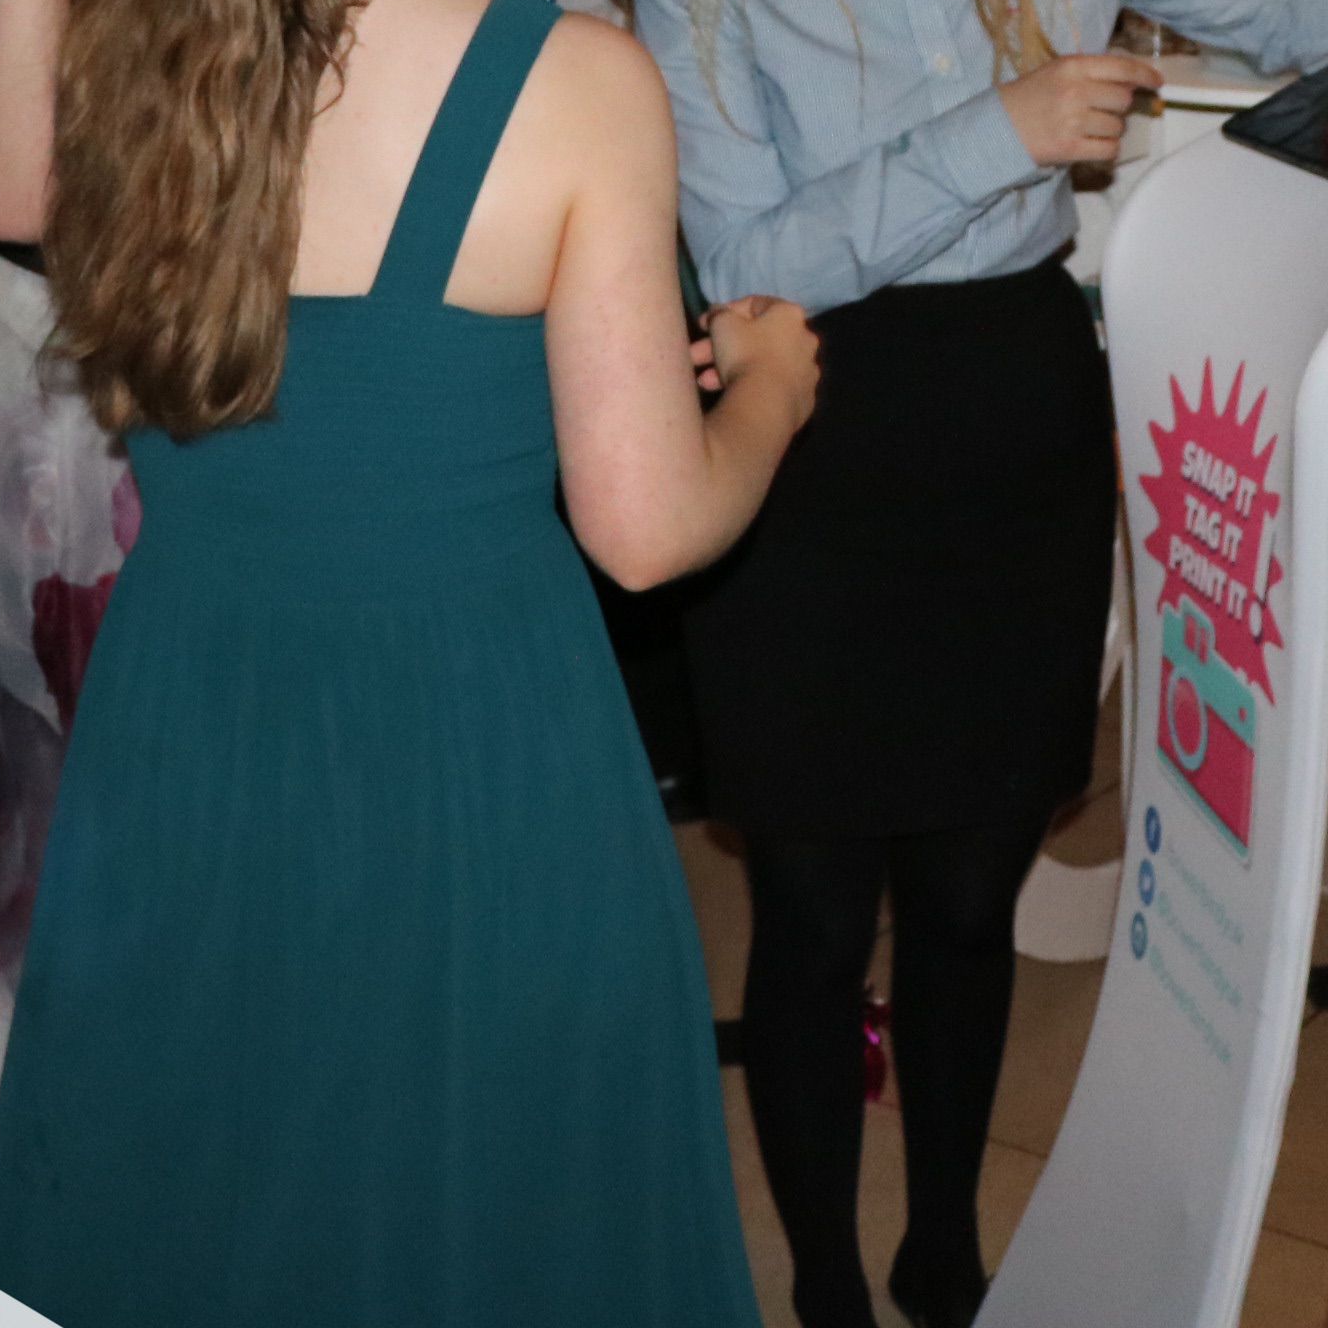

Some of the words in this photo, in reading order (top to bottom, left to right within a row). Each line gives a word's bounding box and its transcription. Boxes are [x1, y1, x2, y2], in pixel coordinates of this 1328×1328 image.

[1181, 439, 1238, 504] SNAP
[1234, 475, 1258, 520] IT
[1183, 494, 1223, 552] TAG
[1221, 521, 1244, 565] IT
[1169, 535, 1228, 606] PRINT
[1226, 579, 1249, 622] IT
